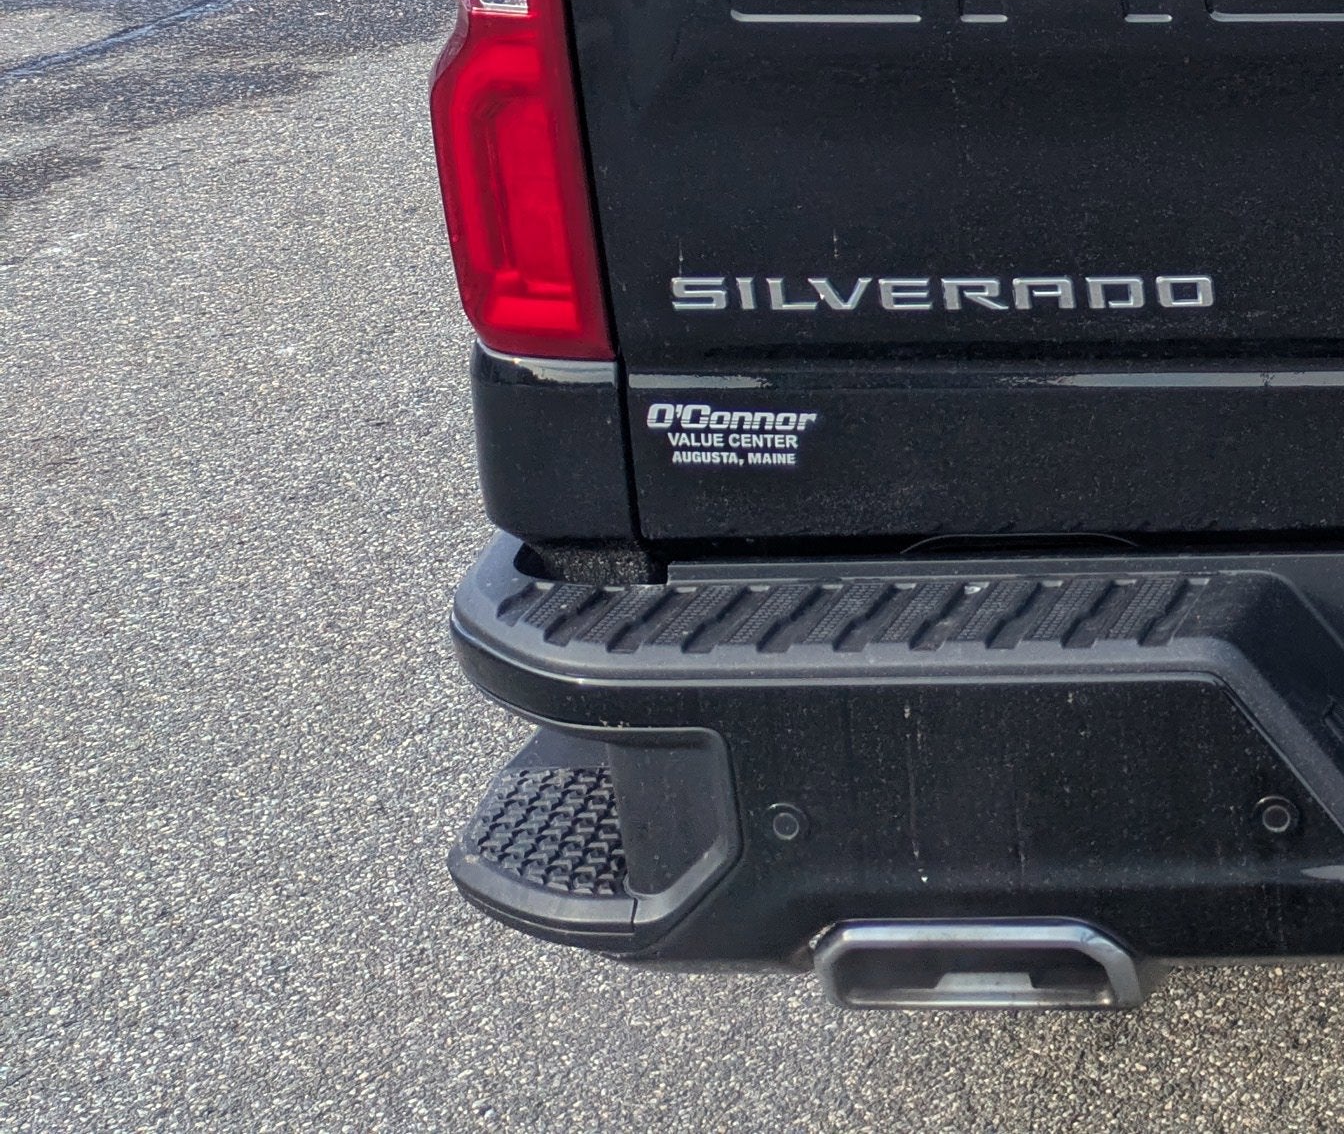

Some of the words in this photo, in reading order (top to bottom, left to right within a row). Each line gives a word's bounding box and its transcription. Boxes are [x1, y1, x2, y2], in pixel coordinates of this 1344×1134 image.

[671, 274, 1215, 311] SILVERADO
[647, 403, 817, 431] O'Connor
[667, 432, 725, 447] VALUE
[728, 434, 798, 449] CENTER
[672, 451, 744, 467] AUGUSTA,
[747, 452, 796, 464] MAINE
